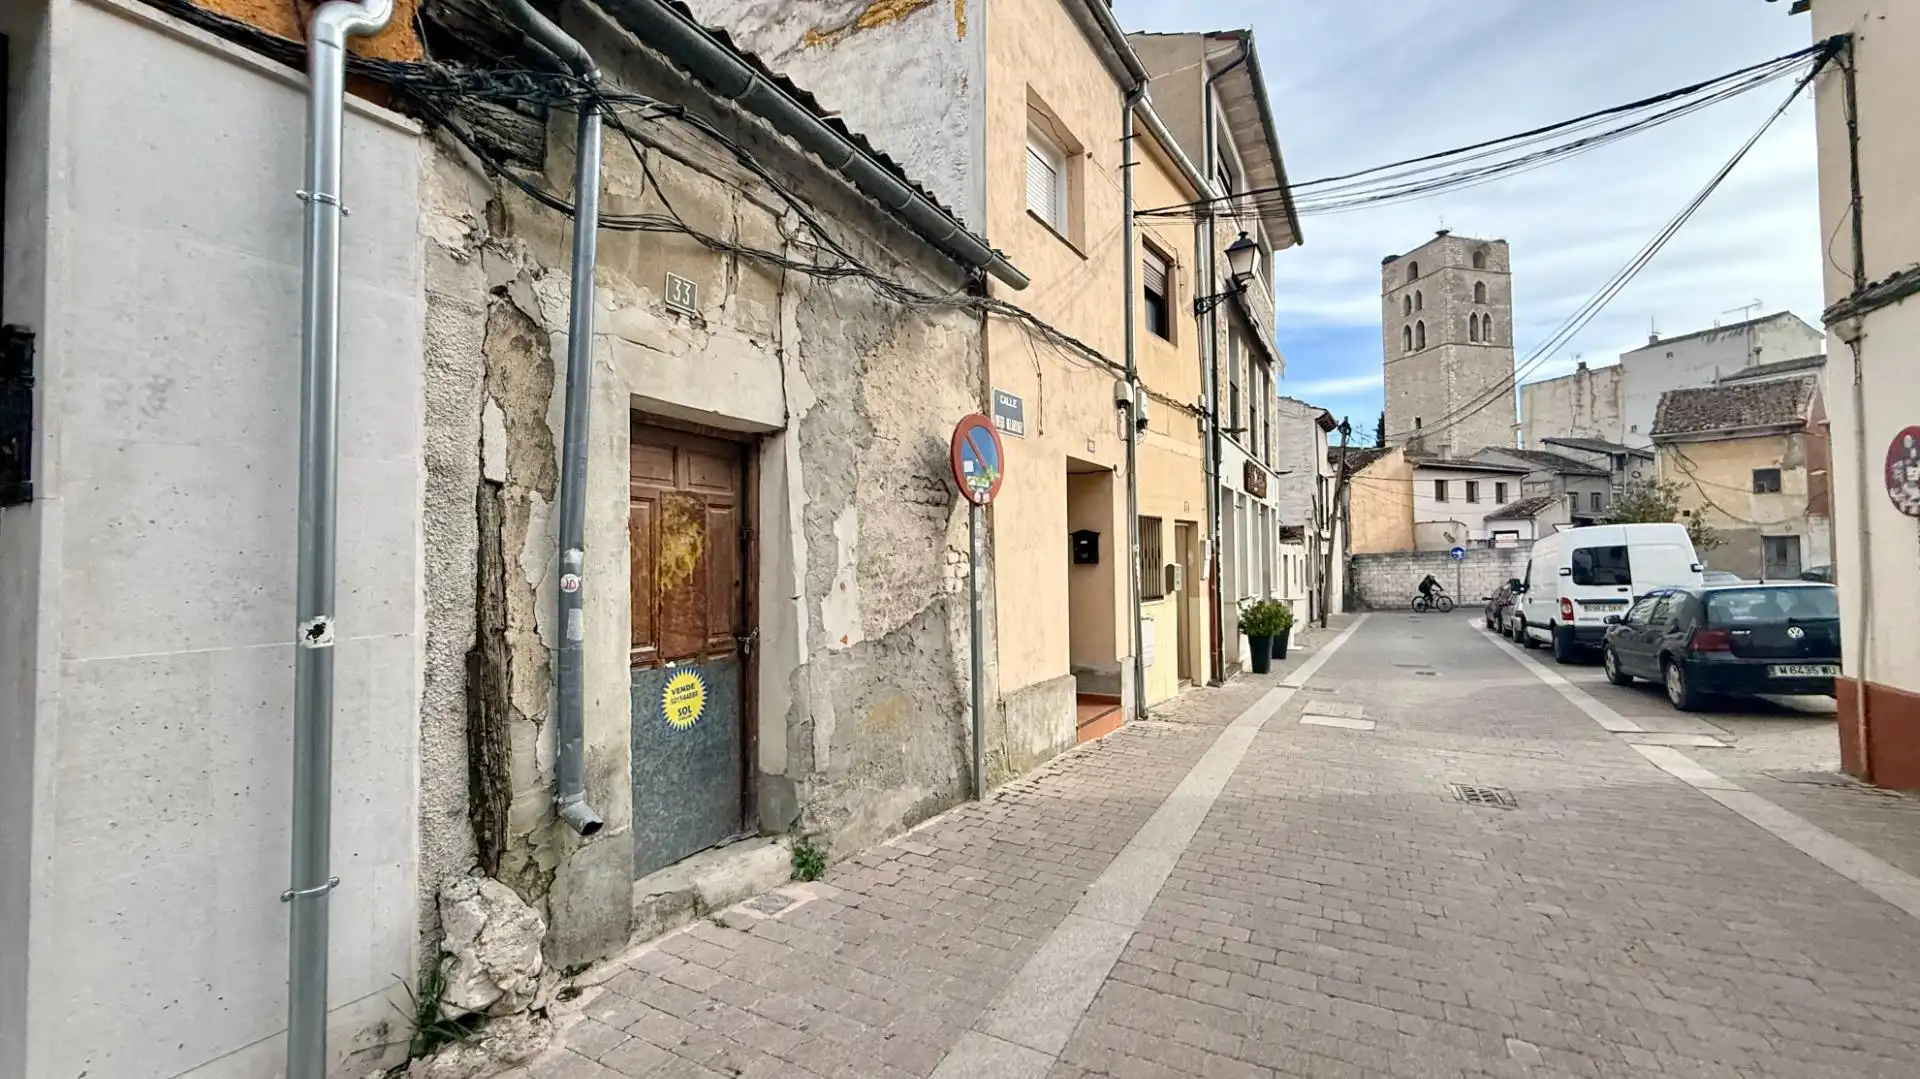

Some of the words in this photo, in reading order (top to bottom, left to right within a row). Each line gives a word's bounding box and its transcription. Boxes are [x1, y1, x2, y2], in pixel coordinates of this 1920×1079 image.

[673, 278, 690, 305] 33
[999, 394, 1018, 409] CALLE
[1779, 665, 1787, 674] M
[1789, 665, 1819, 675] 6435
[671, 682, 696, 695] VENDE
[677, 704, 693, 717] SOL
